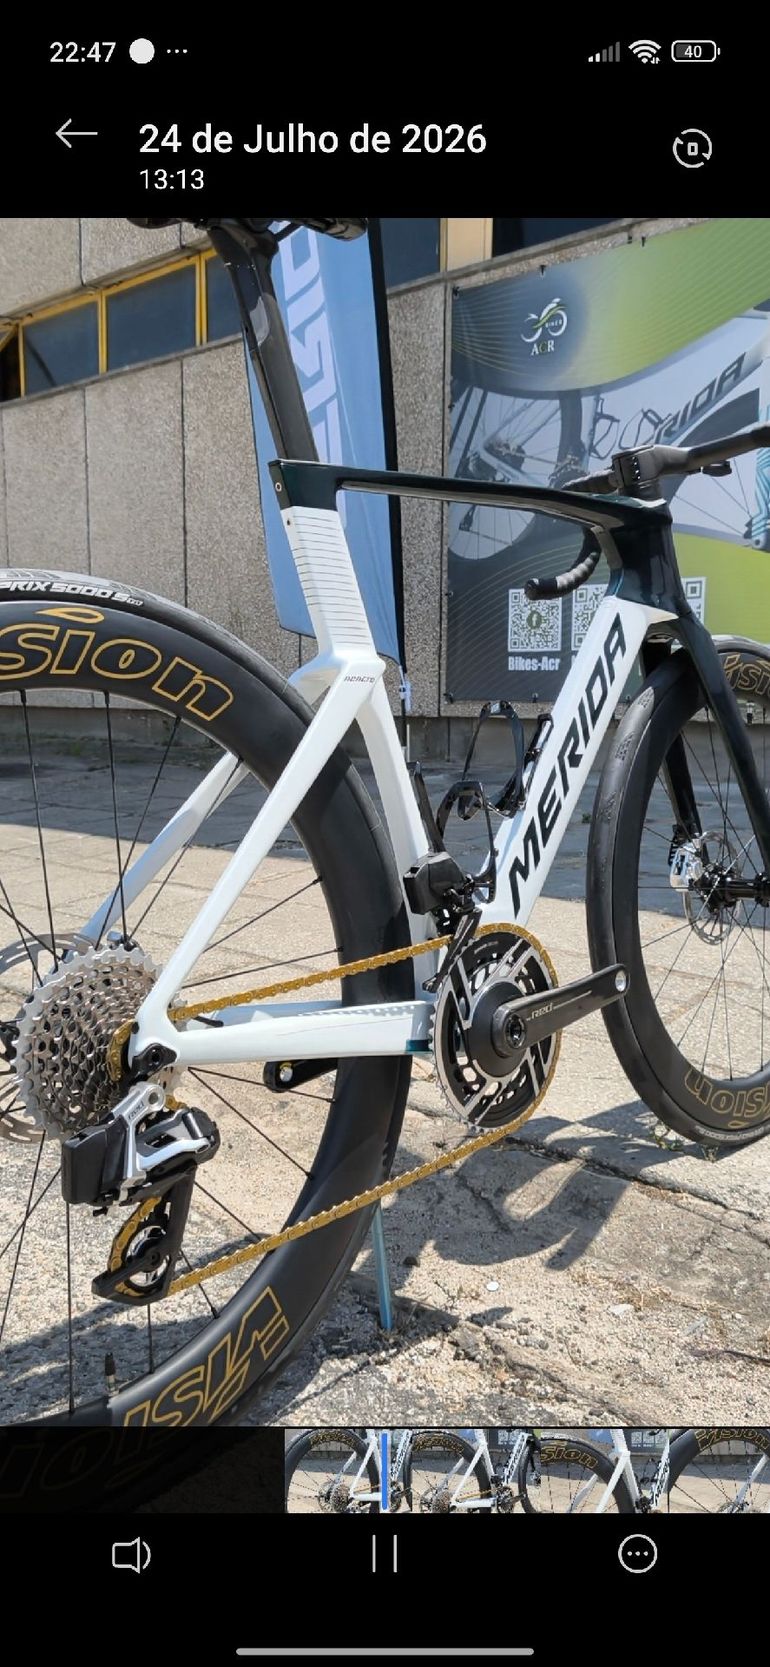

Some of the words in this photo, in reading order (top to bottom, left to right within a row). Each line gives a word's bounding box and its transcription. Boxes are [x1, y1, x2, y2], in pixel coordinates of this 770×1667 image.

[50, 42, 116, 62] 22:47
[684, 45, 702, 58] 40
[140, 124, 181, 152] 24
[193, 123, 232, 153] de
[244, 123, 338, 153] Julho
[350, 123, 390, 153] de
[402, 124, 486, 153] 2026
[140, 169, 204, 189] 13:13
[531, 339, 555, 356] ACR
[655, 352, 746, 444] RIDA
[50, 582, 111, 598] 5000
[508, 656, 561, 671] Bikes-Acr
[509, 612, 627, 919] MERIDA
